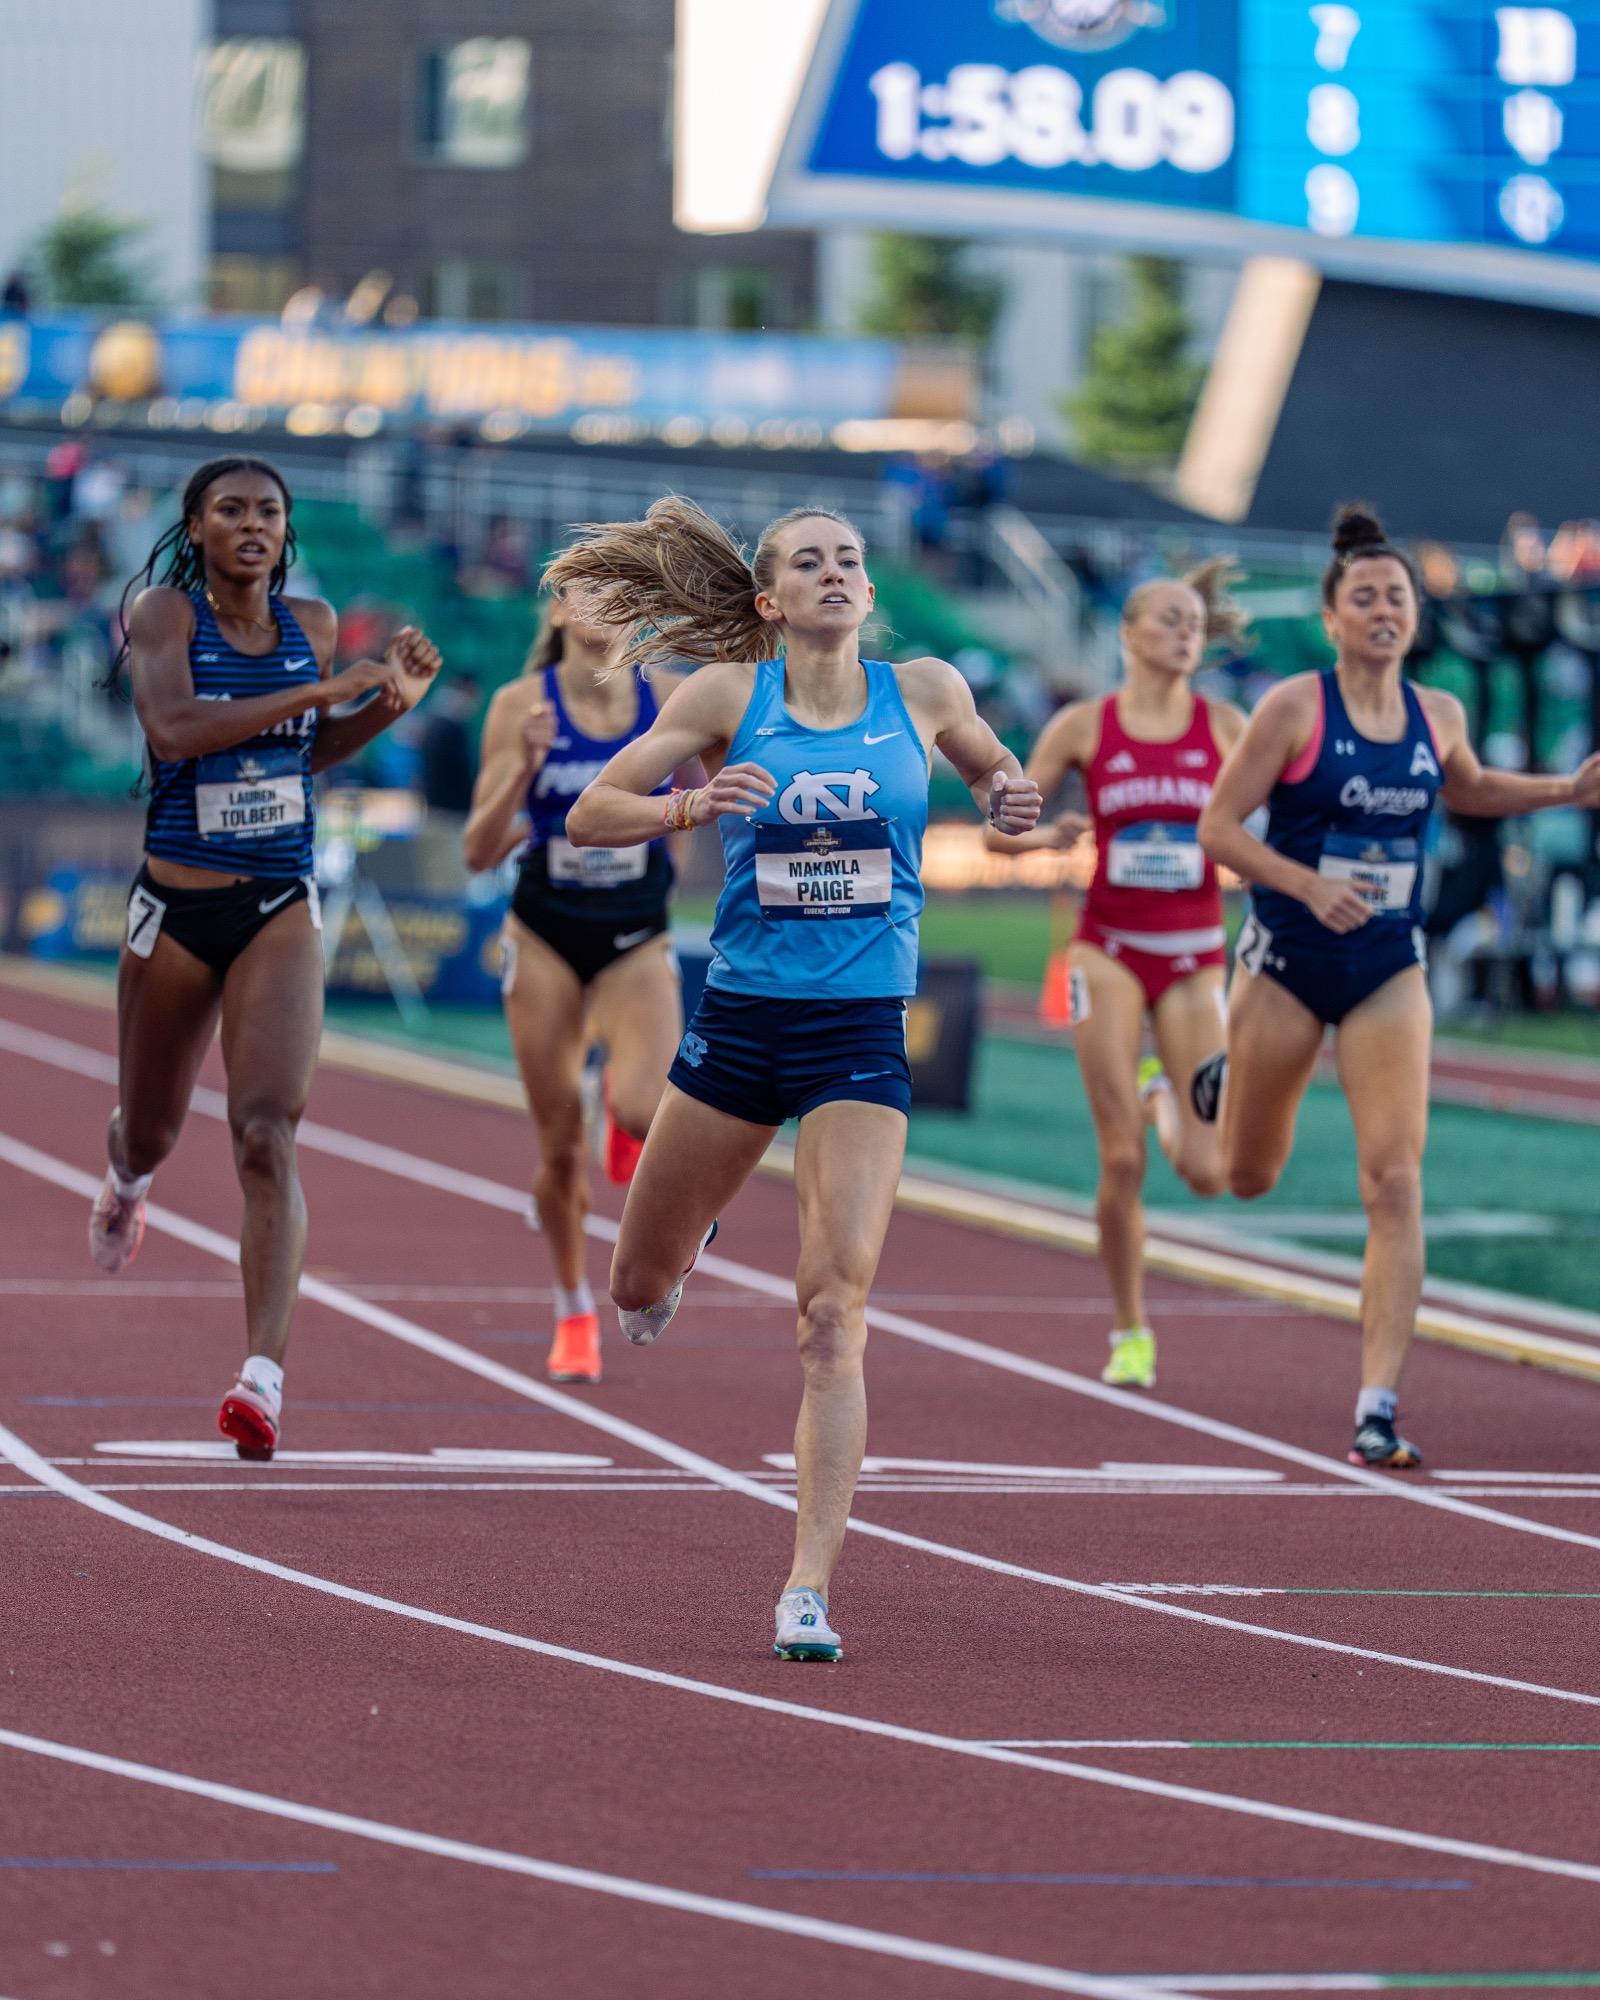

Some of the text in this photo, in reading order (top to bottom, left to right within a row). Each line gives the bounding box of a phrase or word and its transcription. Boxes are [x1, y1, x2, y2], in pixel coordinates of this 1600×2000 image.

[869, 62, 1236, 174] 1:58.09
[220, 804, 285, 828] TOLBERT
[788, 859, 861, 878] MAKAYLA
[797, 880, 854, 902] PAIGE
[130, 895, 158, 944] 7
